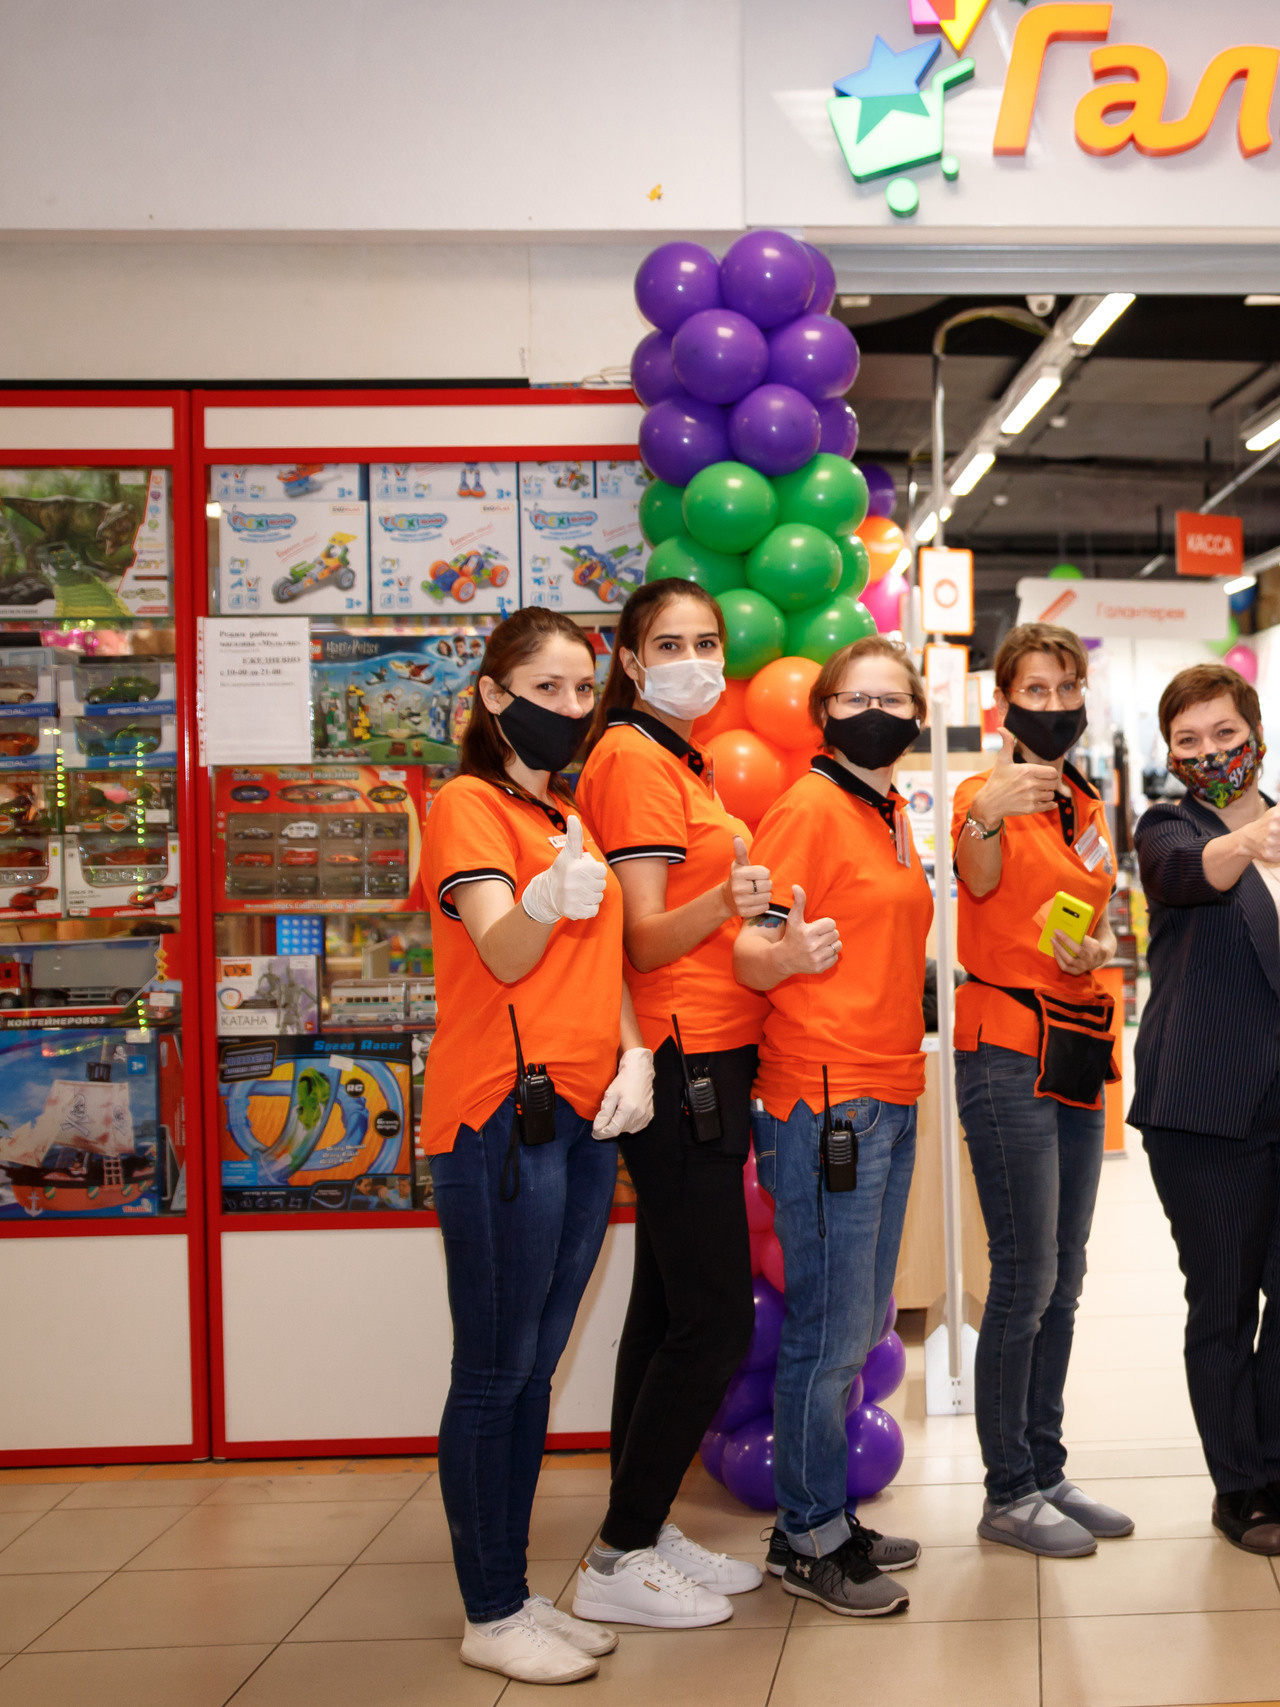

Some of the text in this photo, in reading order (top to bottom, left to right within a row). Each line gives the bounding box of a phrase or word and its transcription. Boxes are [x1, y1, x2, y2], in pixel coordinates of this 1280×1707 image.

[1185, 533, 1234, 556] КАССА
[1096, 601, 1187, 622] Галантерея
[7, 1016, 106, 1027] КОНТЕЙНЕРОВОЗ
[220, 1015, 268, 1026] КАТАНА
[313, 1039, 403, 1052] Speed Racer
